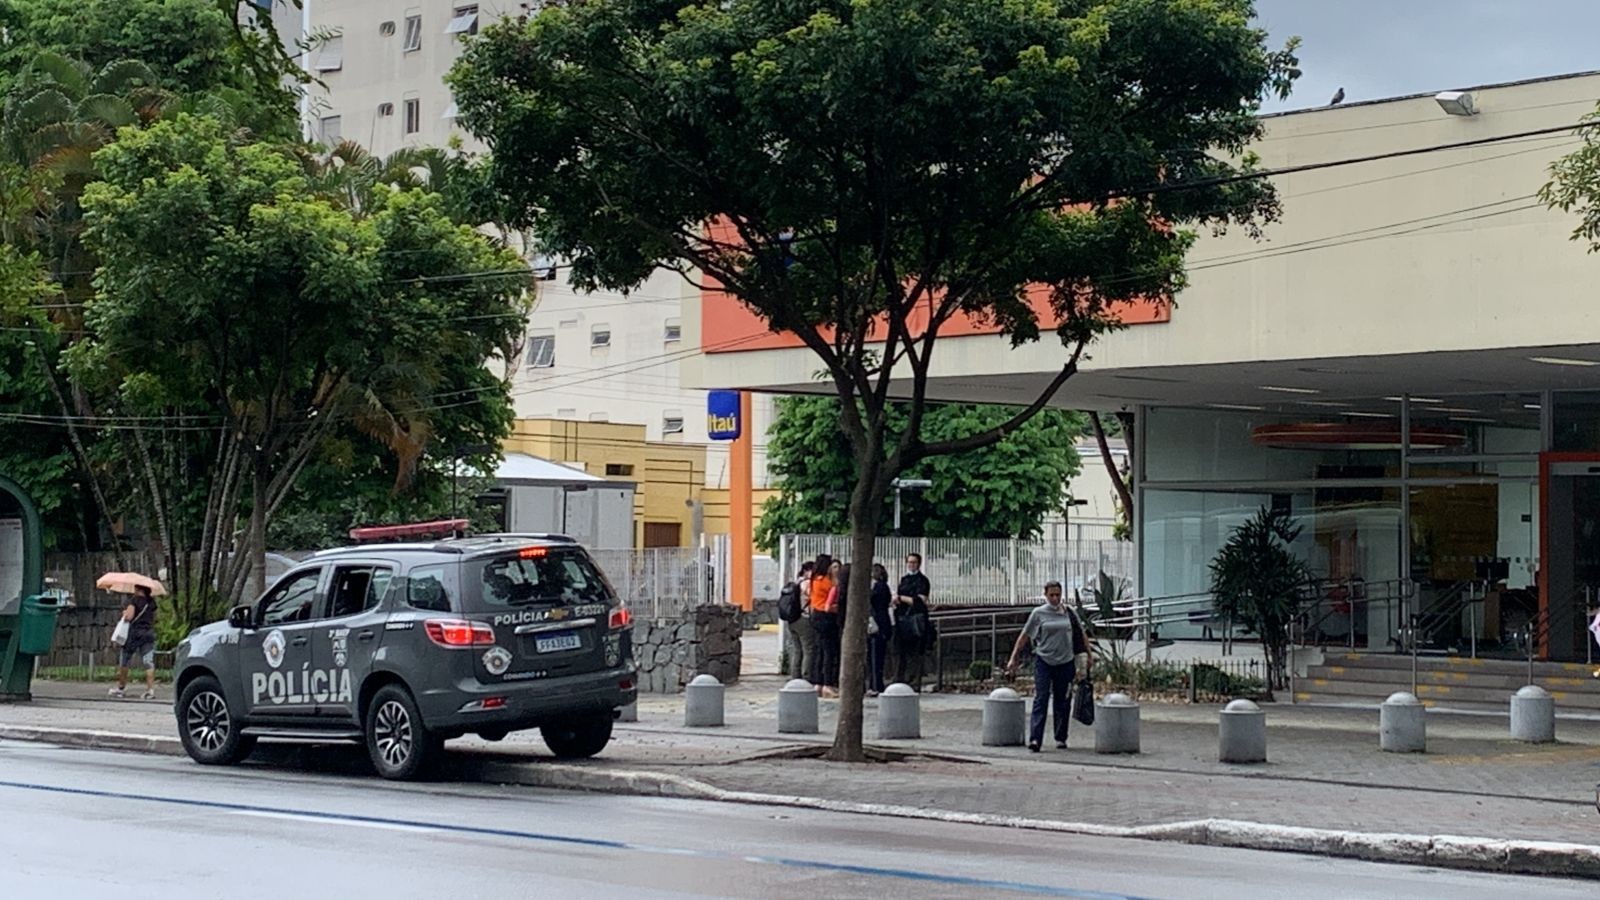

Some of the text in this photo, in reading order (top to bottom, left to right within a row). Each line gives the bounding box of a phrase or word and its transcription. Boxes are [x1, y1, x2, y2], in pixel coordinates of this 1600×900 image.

[708, 412, 736, 432] Itaú
[494, 610, 544, 626] POLÍCIA
[252, 661, 353, 705] POLÍCIA
